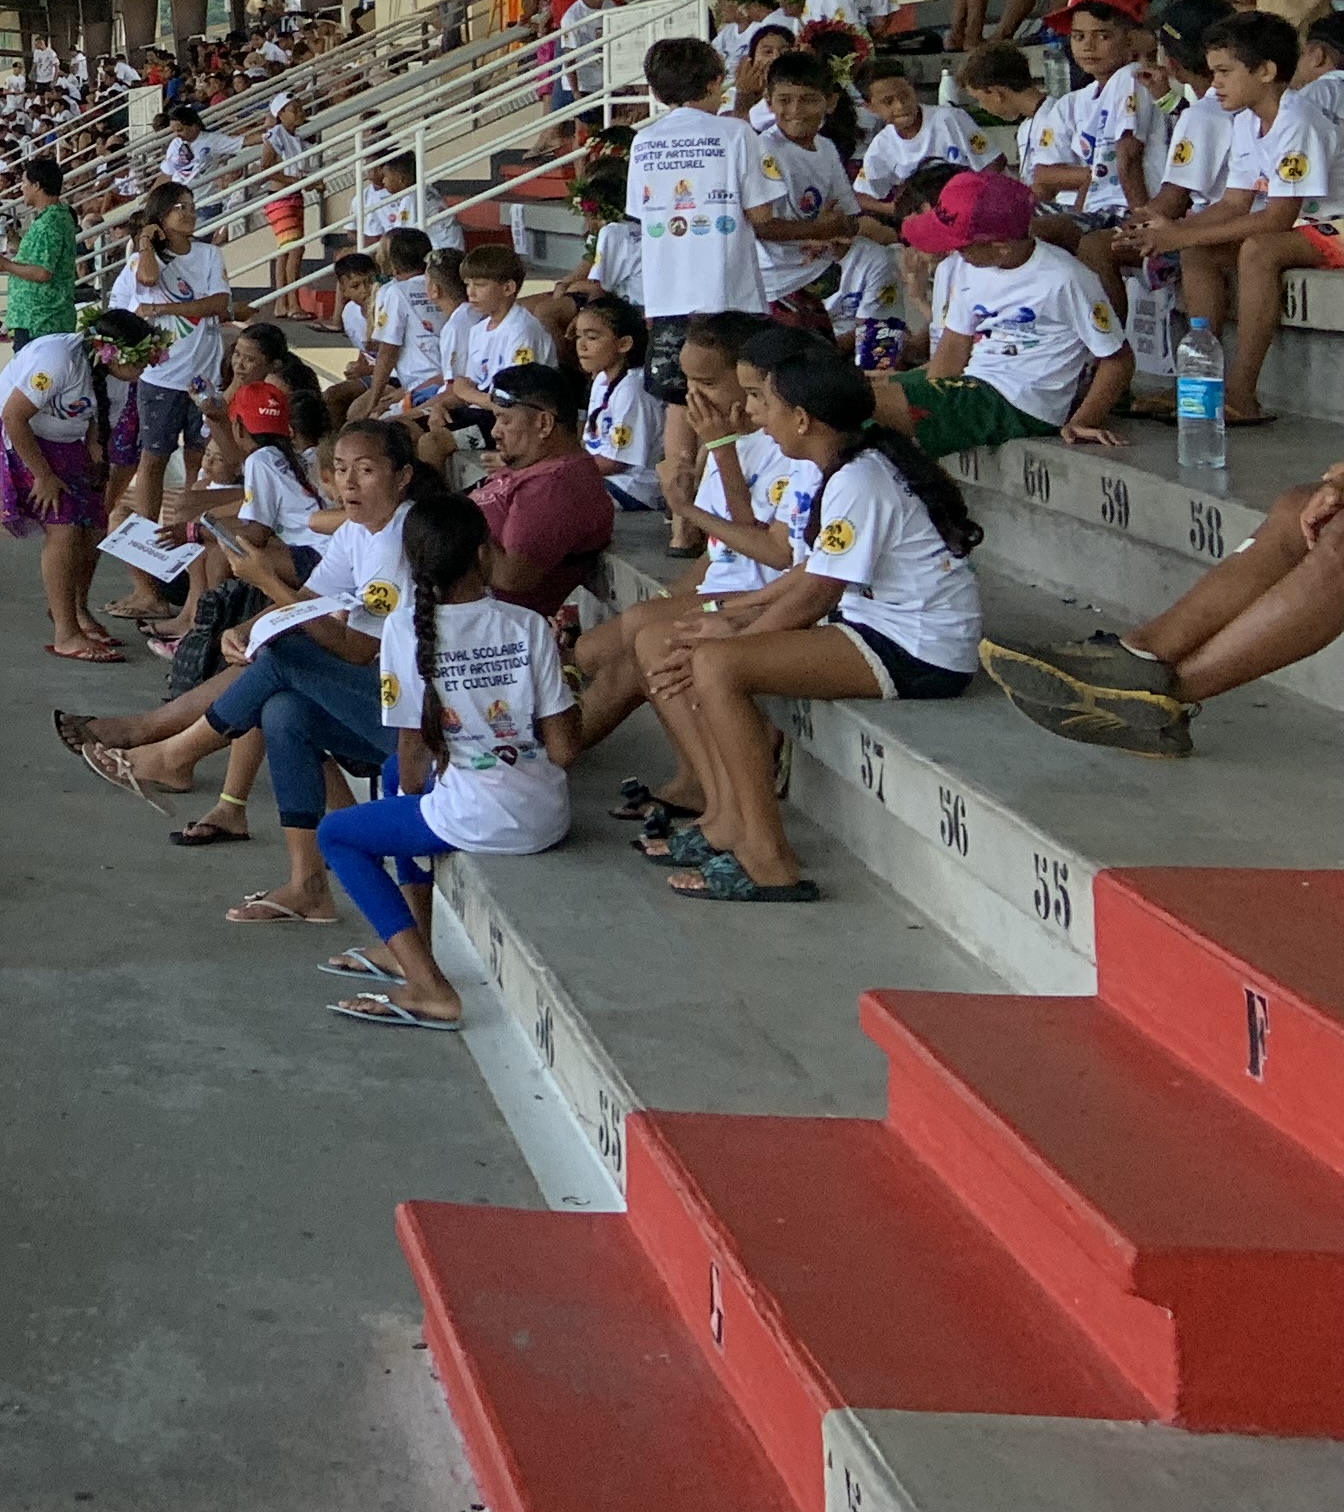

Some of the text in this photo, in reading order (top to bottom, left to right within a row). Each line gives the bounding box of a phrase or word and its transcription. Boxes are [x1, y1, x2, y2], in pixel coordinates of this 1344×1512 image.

[634, 138, 720, 152] FESTIVAL SCOLAIRE
[665, 148, 726, 158] ARTISTIQUE
[643, 160, 705, 171] ET CULTUREL
[1101, 476, 1130, 529] 59
[1189, 500, 1225, 558] 58
[470, 655, 529, 674] ARTISTIQU
[472, 641, 527, 659] SCOLAIRE
[444, 673, 518, 692] ET CULTUREL
[860, 732, 885, 804] 57
[939, 786, 968, 857] 56
[1033, 852, 1072, 929] 55
[599, 1090, 622, 1172] 55
